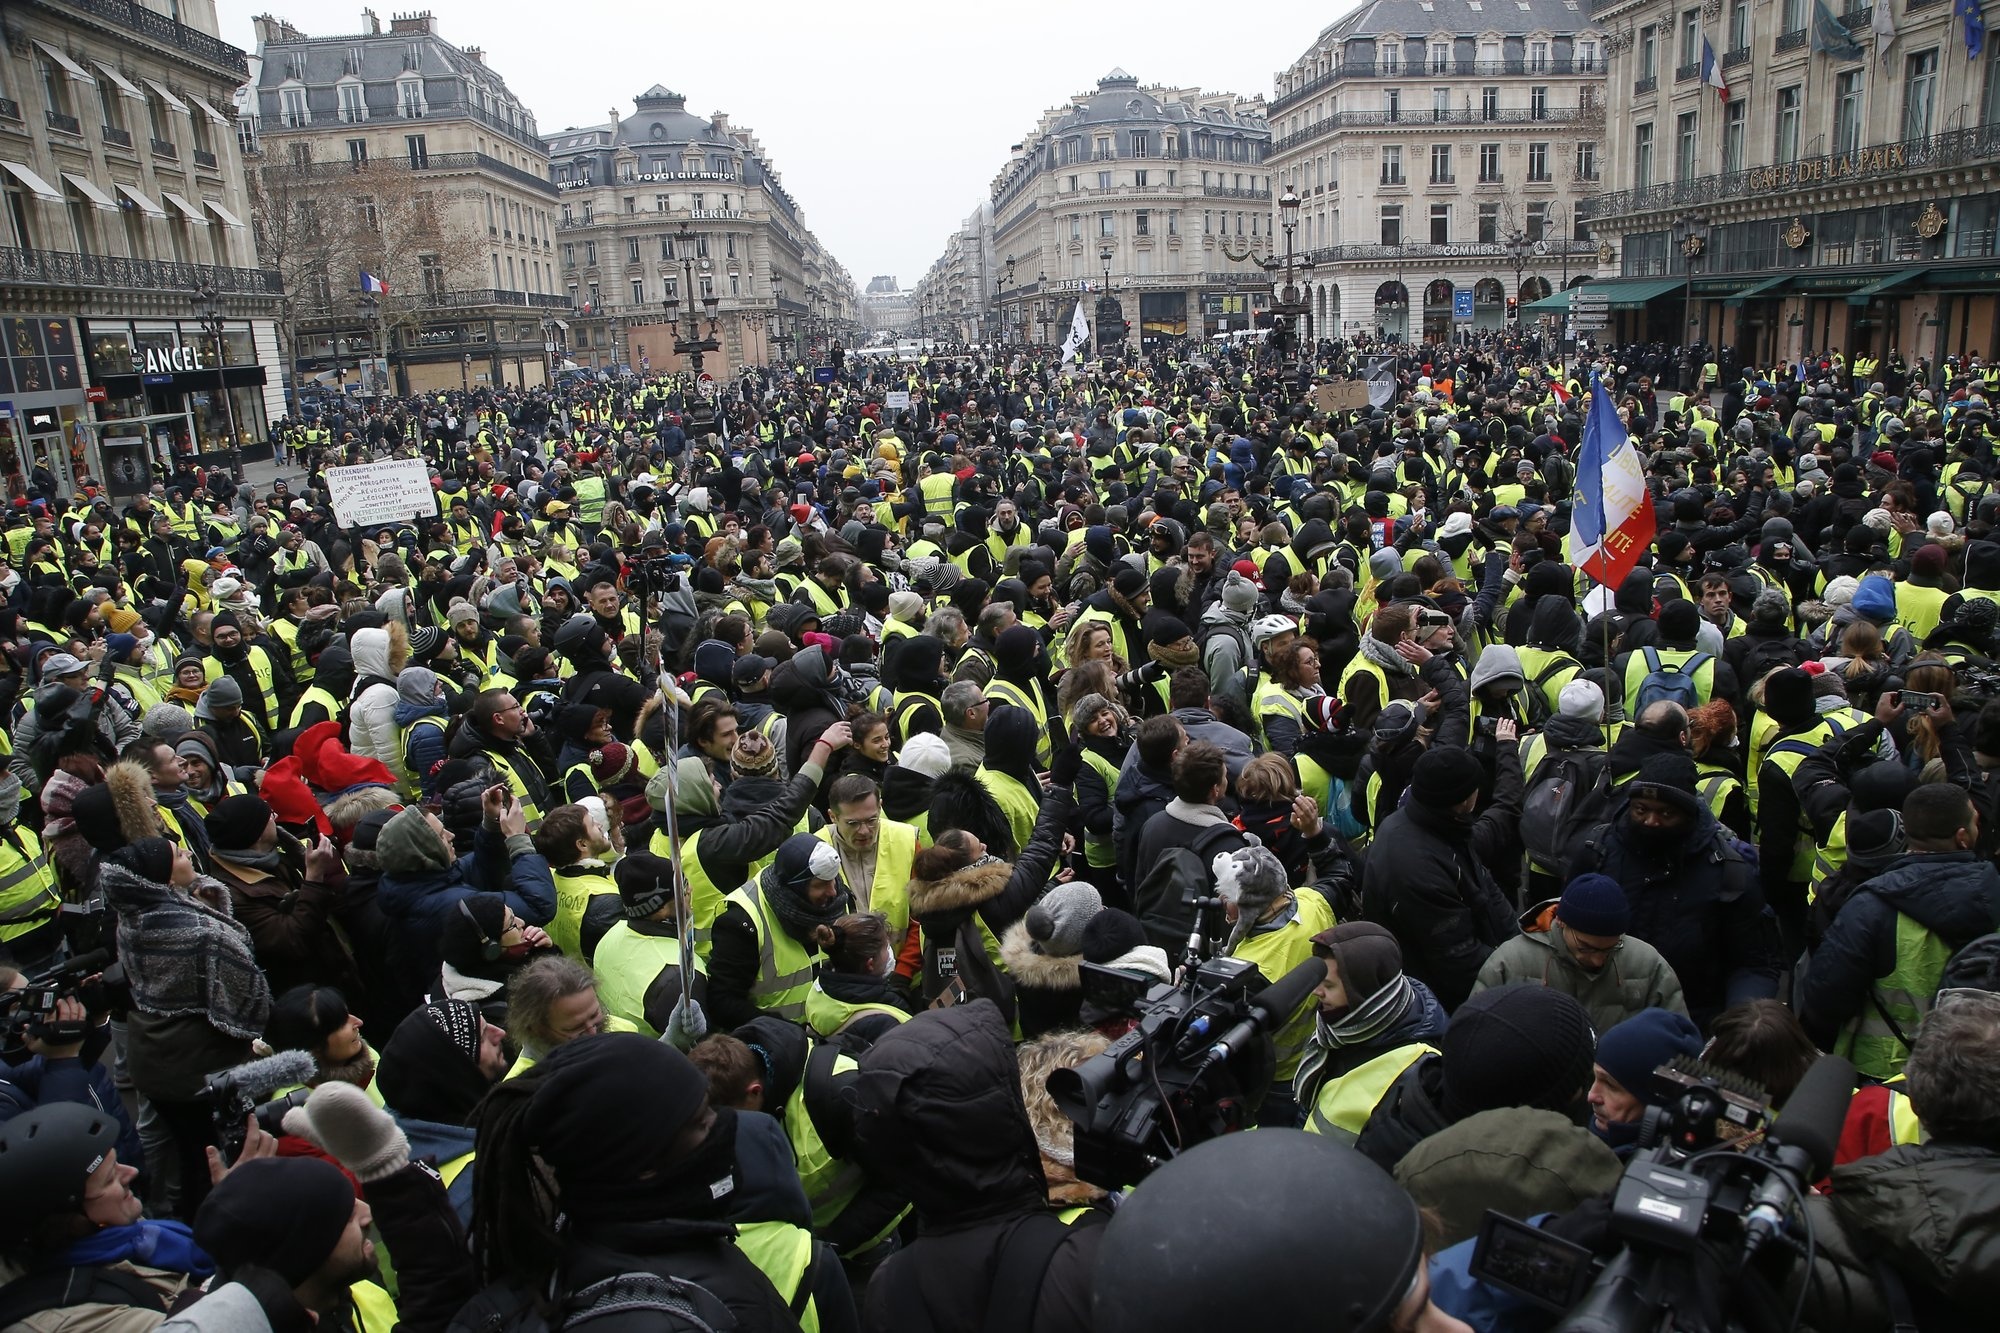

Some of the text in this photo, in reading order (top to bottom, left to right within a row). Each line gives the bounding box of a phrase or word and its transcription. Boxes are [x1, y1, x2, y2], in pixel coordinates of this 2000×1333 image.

[1798, 160, 1822, 182] DE
[1828, 154, 1851, 177] LA
[1859, 144, 1907, 172] PAIX
[637, 171, 674, 181] royal
[700, 171, 735, 180] maroc
[557, 178, 590, 189] maroc
[691, 209, 742, 219] BERLITZ
[421, 330, 456, 339] MATY
[327, 337, 362, 346] MATY
[131, 354, 143, 363] BUS
[132, 346, 203, 373] ANCEL
[1327, 387, 1357, 401] RIC
